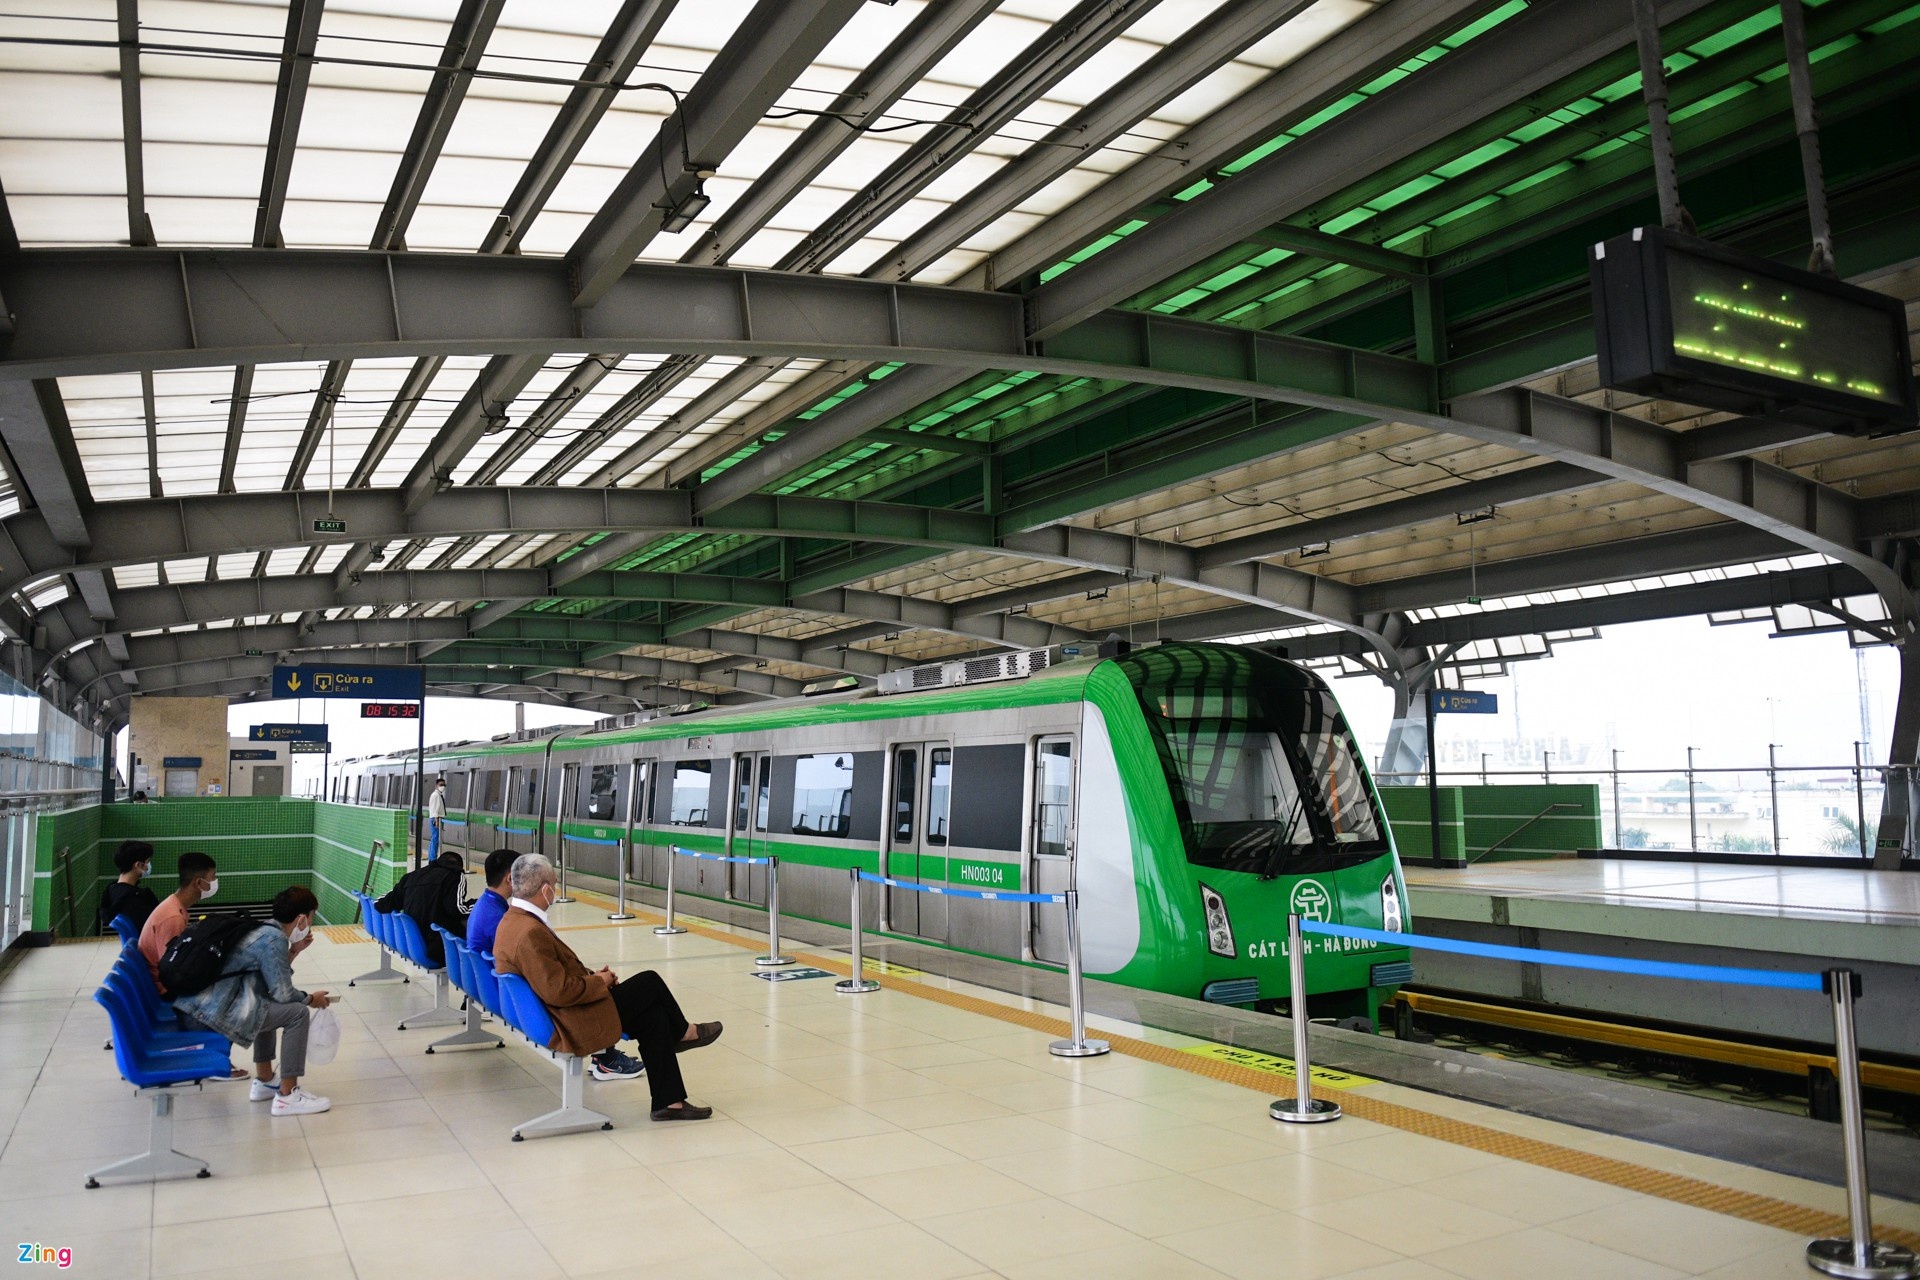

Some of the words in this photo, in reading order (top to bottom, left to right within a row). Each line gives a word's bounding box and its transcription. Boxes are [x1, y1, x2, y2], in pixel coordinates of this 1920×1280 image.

[336, 673, 359, 684] Cửa
[362, 676, 373, 684] ra
[961, 865, 990, 882] HN003
[992, 868, 1003, 883] 04
[1249, 940, 1276, 958] CÁT
[1281, 939, 1312, 956] LH
[1324, 935, 1341, 953] HÀ
